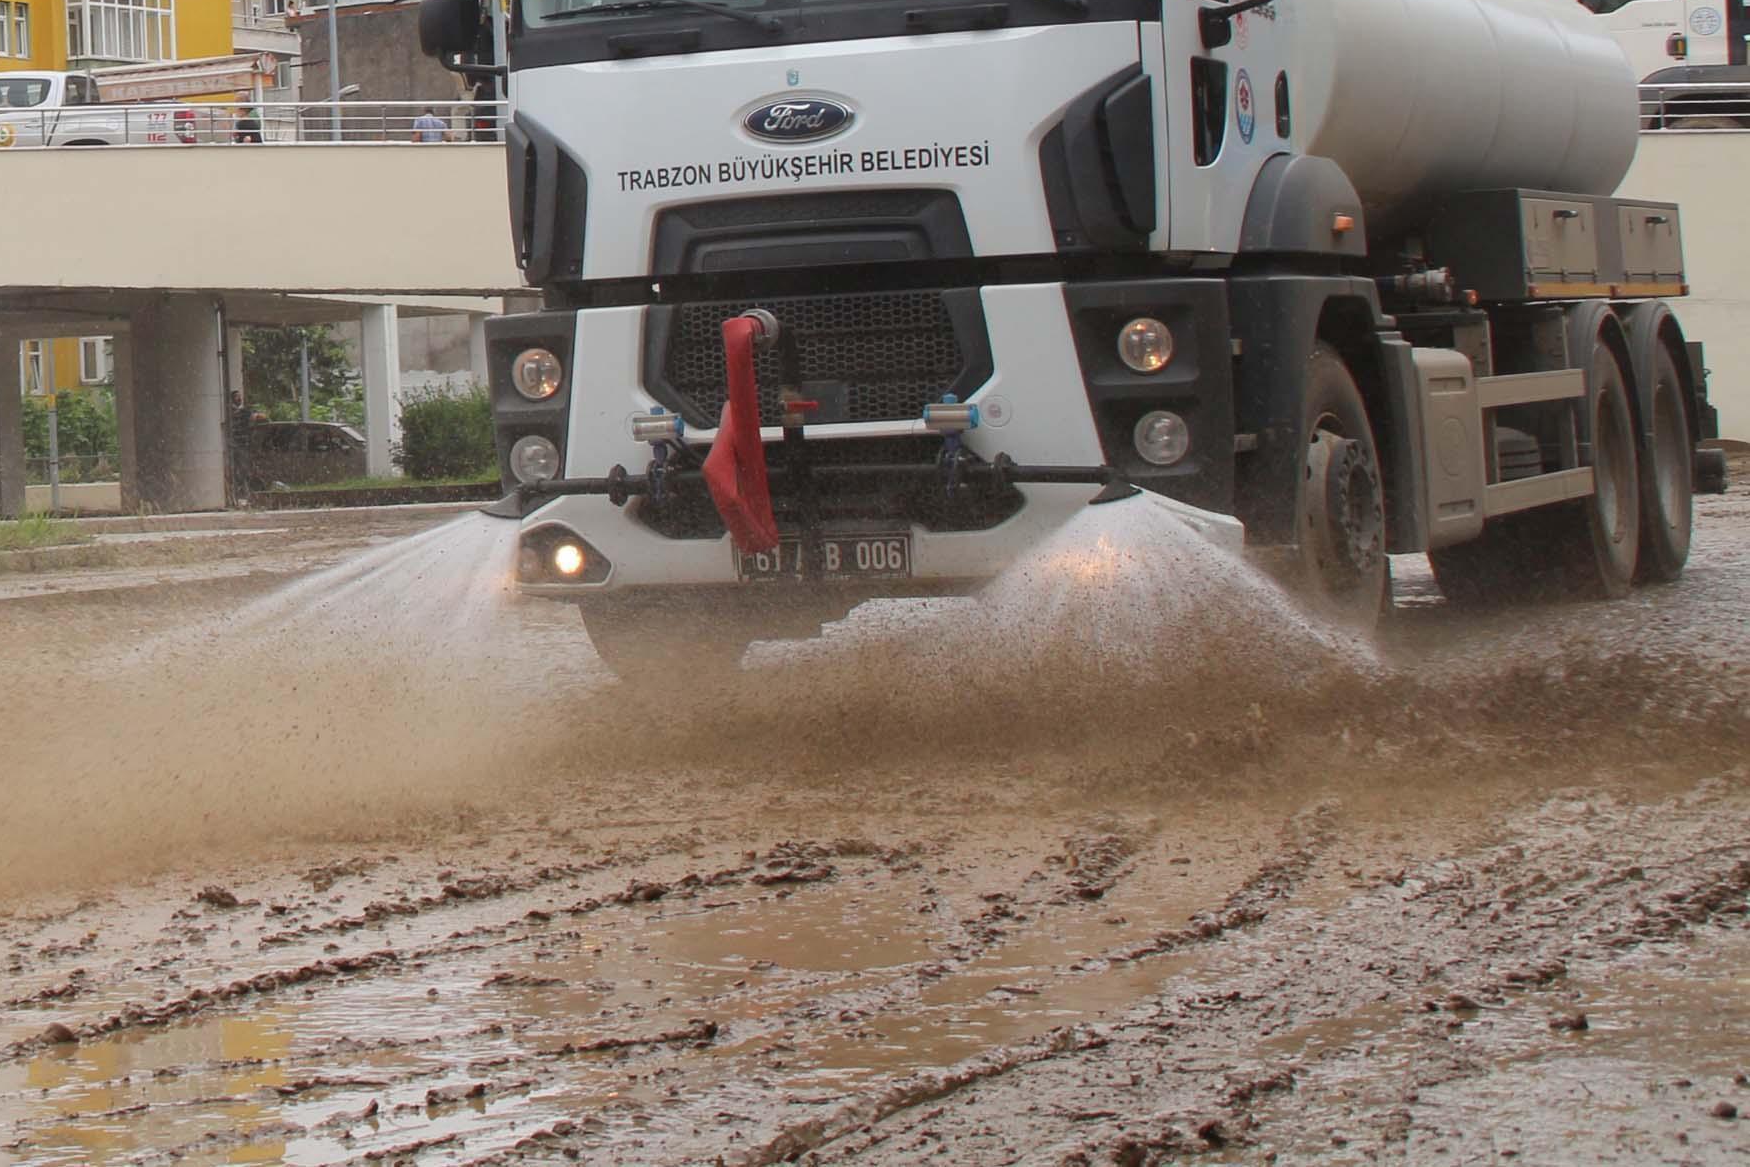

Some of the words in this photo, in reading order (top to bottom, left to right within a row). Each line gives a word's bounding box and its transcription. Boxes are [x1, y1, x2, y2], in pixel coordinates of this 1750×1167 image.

[764, 103, 825, 131] Ford
[618, 165, 711, 191] TRABZON
[719, 149, 853, 182] BÜYÜKŞEHİR
[861, 140, 990, 172] BELEDİYESİ
[856, 542, 902, 571] 006
